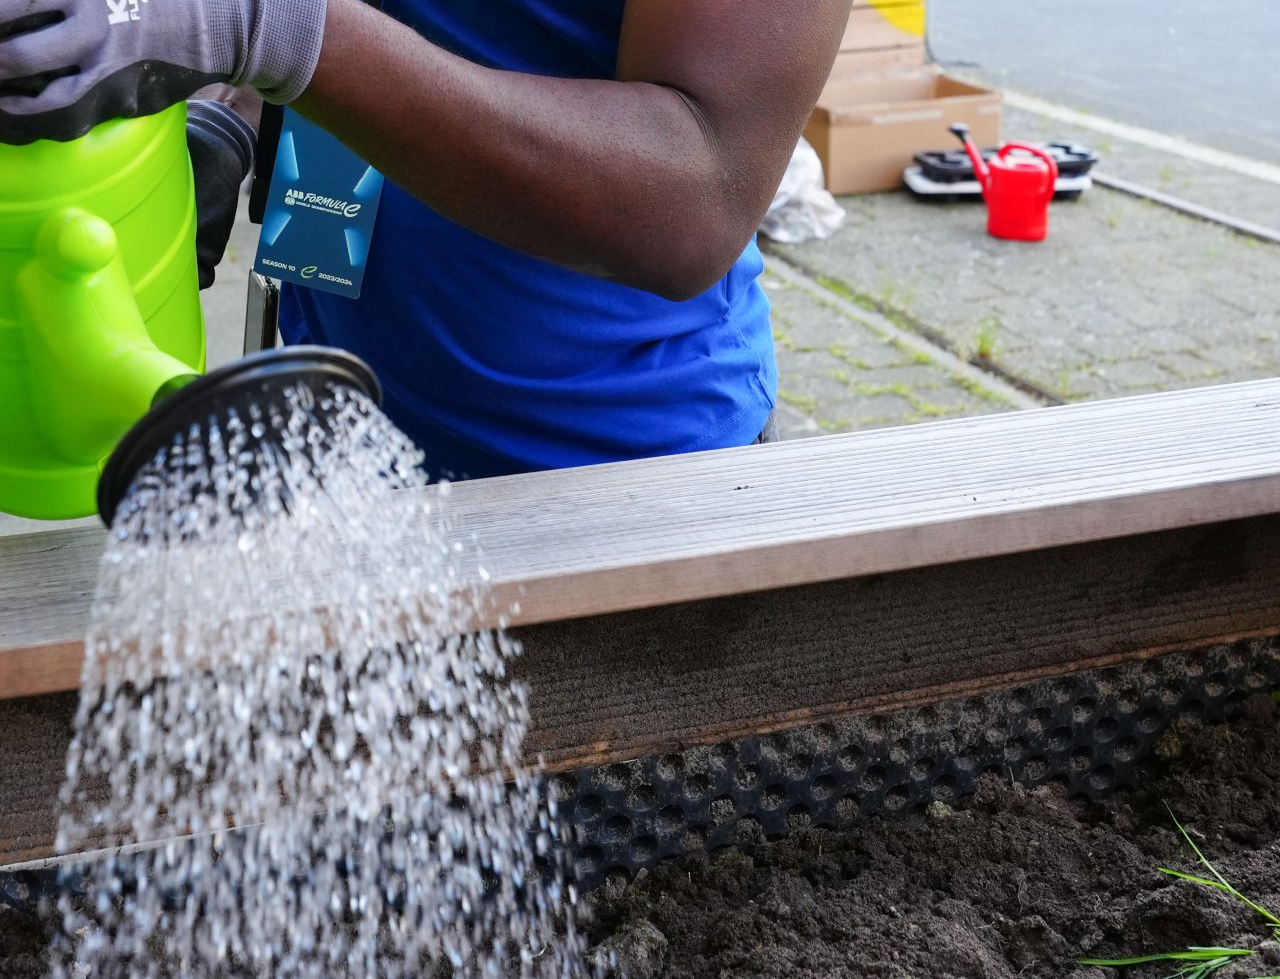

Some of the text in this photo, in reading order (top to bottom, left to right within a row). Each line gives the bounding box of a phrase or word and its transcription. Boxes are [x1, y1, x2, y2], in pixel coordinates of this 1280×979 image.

[285, 188, 304, 200] ABB
[303, 192, 348, 211] FORMULA
[261, 258, 288, 270] SEASON
[287, 264, 296, 272] 10
[318, 272, 353, 286] 2023/2024
